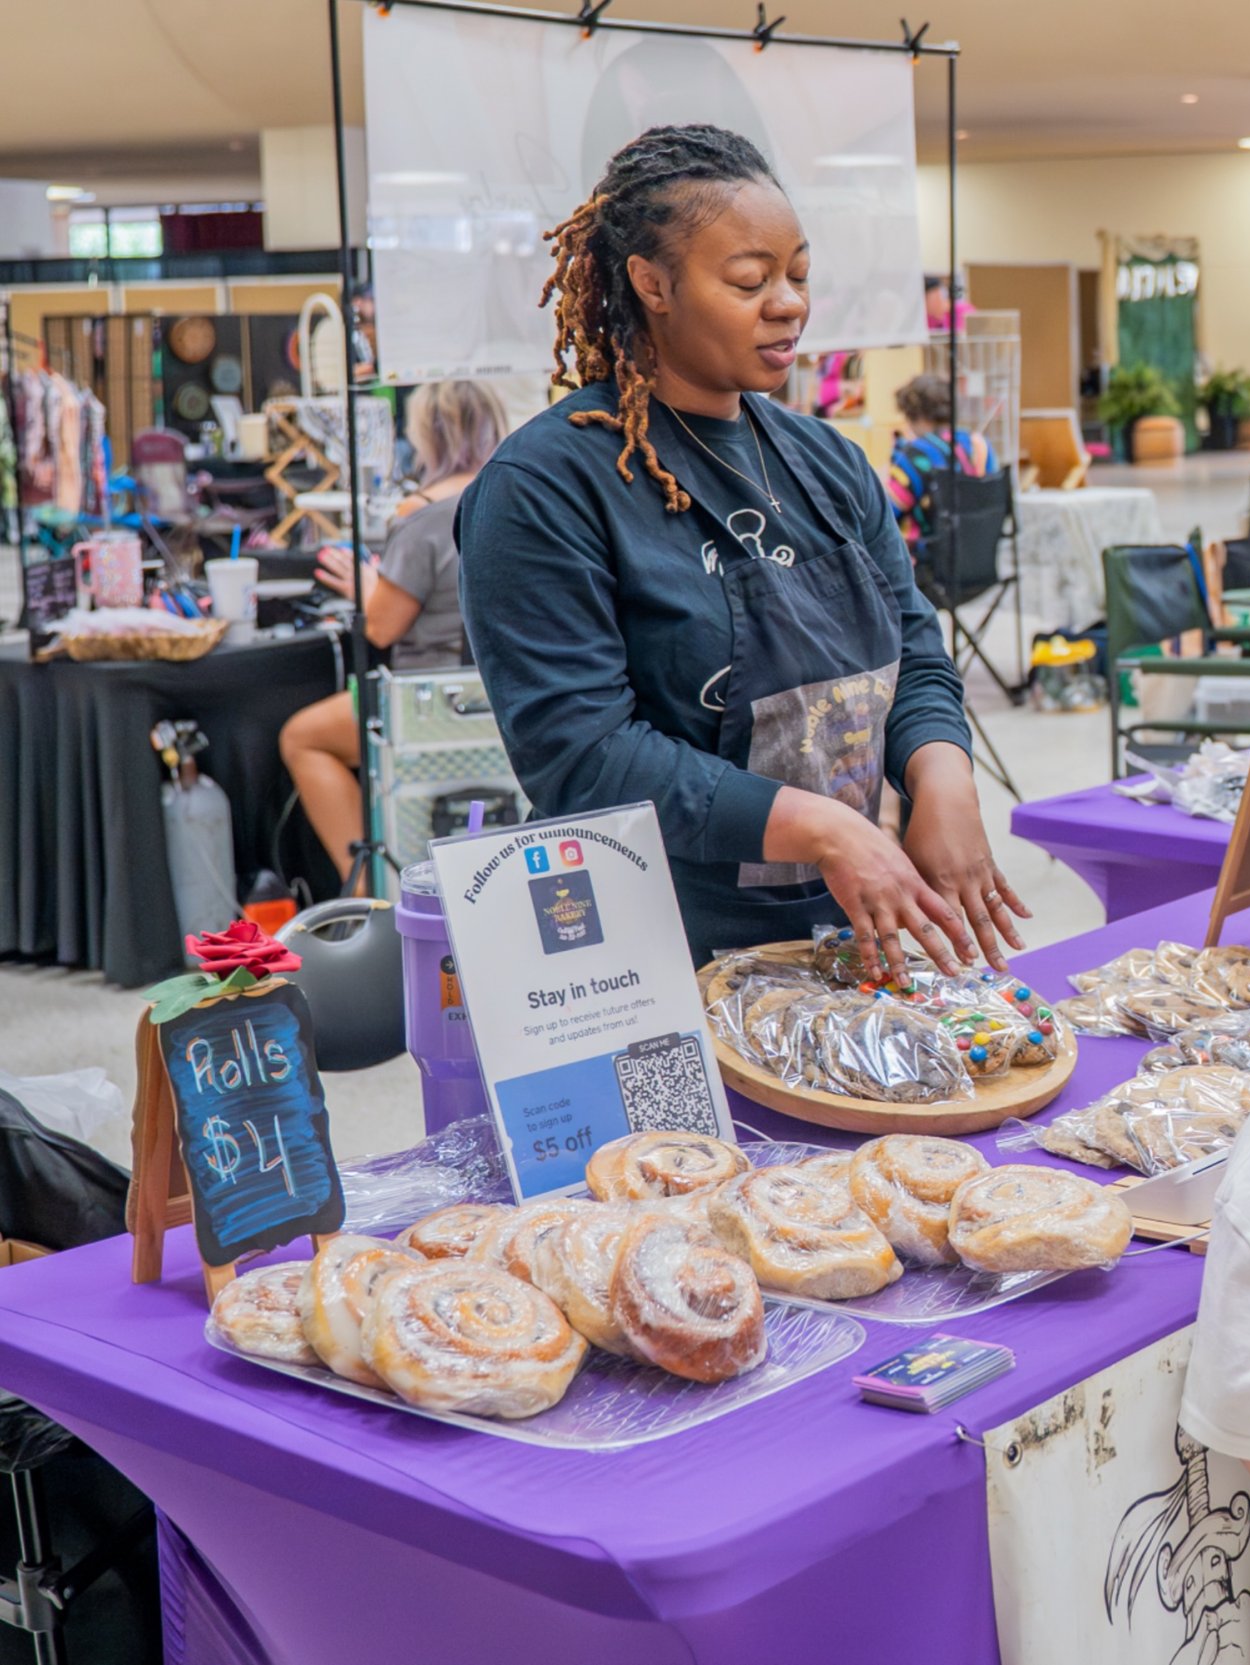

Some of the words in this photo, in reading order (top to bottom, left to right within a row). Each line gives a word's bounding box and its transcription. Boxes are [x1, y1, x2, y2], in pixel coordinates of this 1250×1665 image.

[463, 856, 500, 905] Follow
[499, 843, 516, 860] us
[514, 833, 536, 850] for
[527, 988, 566, 1009] Stay
[569, 983, 587, 1000] in
[590, 969, 640, 994] touch
[523, 1023, 545, 1037] Sign
[546, 1021, 558, 1032] up
[559, 1018, 569, 1027] to
[570, 1011, 601, 1025] receive
[602, 1005, 629, 1017] future
[631, 998, 656, 1010] offers
[548, 1034, 566, 1046] and
[567, 1026, 601, 1041] updates
[603, 1020, 624, 1032] from
[186, 1019, 293, 1095] Rolls
[638, 1041, 659, 1053] SCAN
[659, 1038, 671, 1048] ME
[523, 1105, 546, 1118] Scan
[548, 1097, 571, 1111] code
[527, 1122, 537, 1133] to
[539, 1117, 558, 1131] sign
[560, 1113, 573, 1125] up
[202, 1114, 299, 1198] $4
[533, 1136, 560, 1162] $5
[565, 1125, 593, 1151] off
